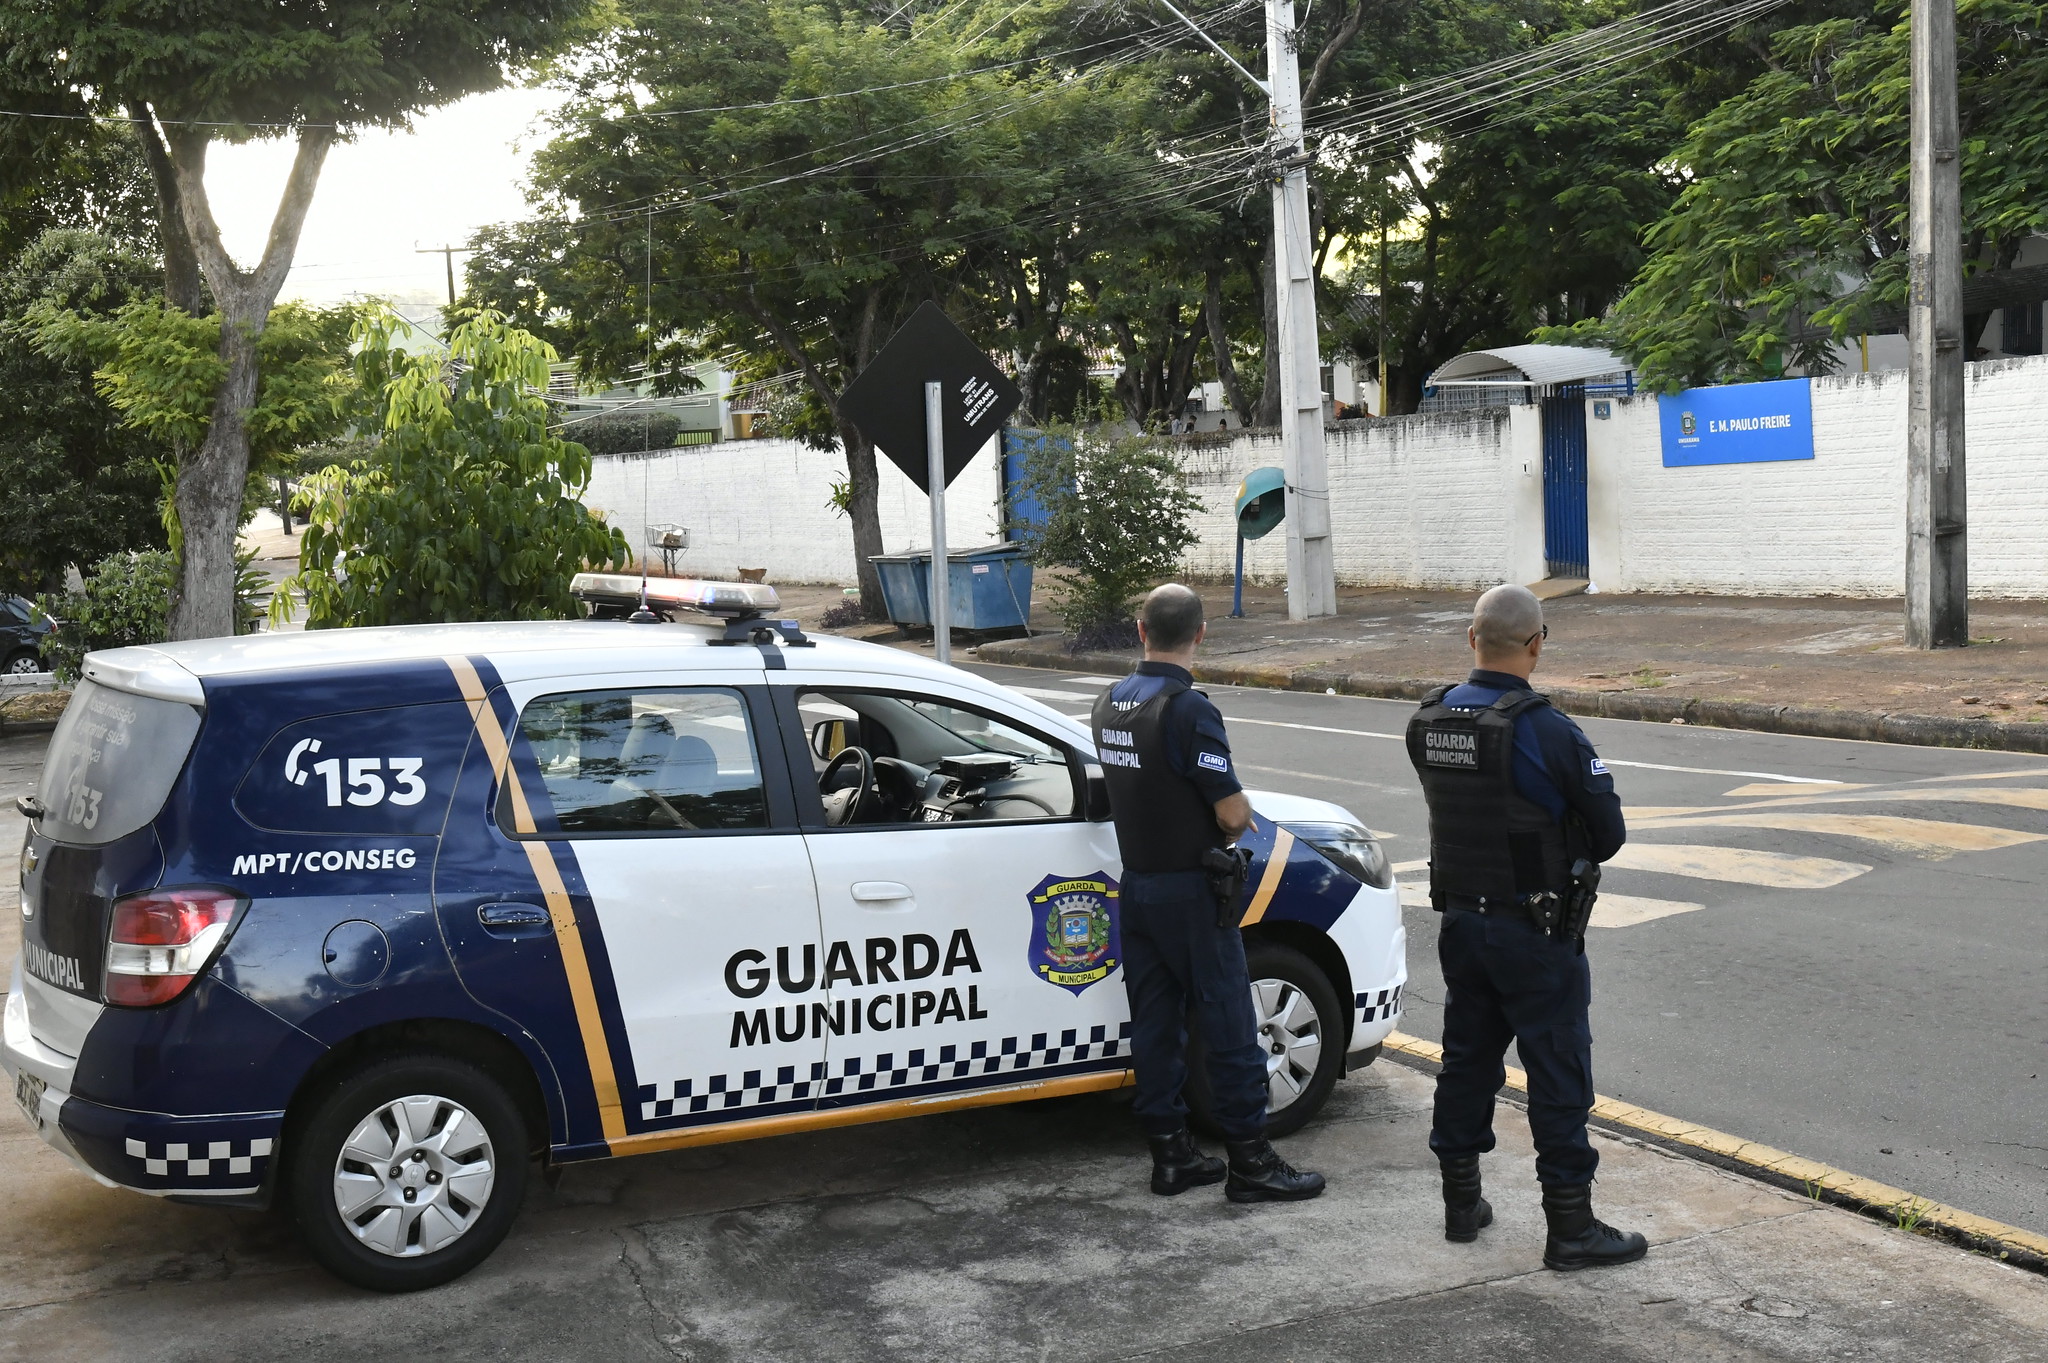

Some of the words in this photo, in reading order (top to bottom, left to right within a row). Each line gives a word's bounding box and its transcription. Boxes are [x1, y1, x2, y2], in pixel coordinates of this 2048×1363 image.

[963, 388, 994, 422] UMUTRANS
[1709, 420, 1718, 433] E.
[1718, 419, 1729, 432] M.
[1730, 417, 1759, 431] PAULO
[1760, 414, 1792, 429] FREIRE
[1102, 728, 1134, 747] GUARDA
[1425, 732, 1476, 751] GUARDA
[1100, 747, 1141, 769] MUNICIPAL
[1203, 755, 1224, 766] GMU
[1426, 749, 1476, 765] MUNICIPAL
[312, 758, 427, 807] 153
[232, 848, 417, 876] MPT/CONSEG
[1056, 882, 1096, 893] GUARDA
[724, 928, 982, 999] GUARDA
[1058, 972, 1097, 984] MUNICIPAL
[729, 985, 988, 1048] MUNICIPAL
